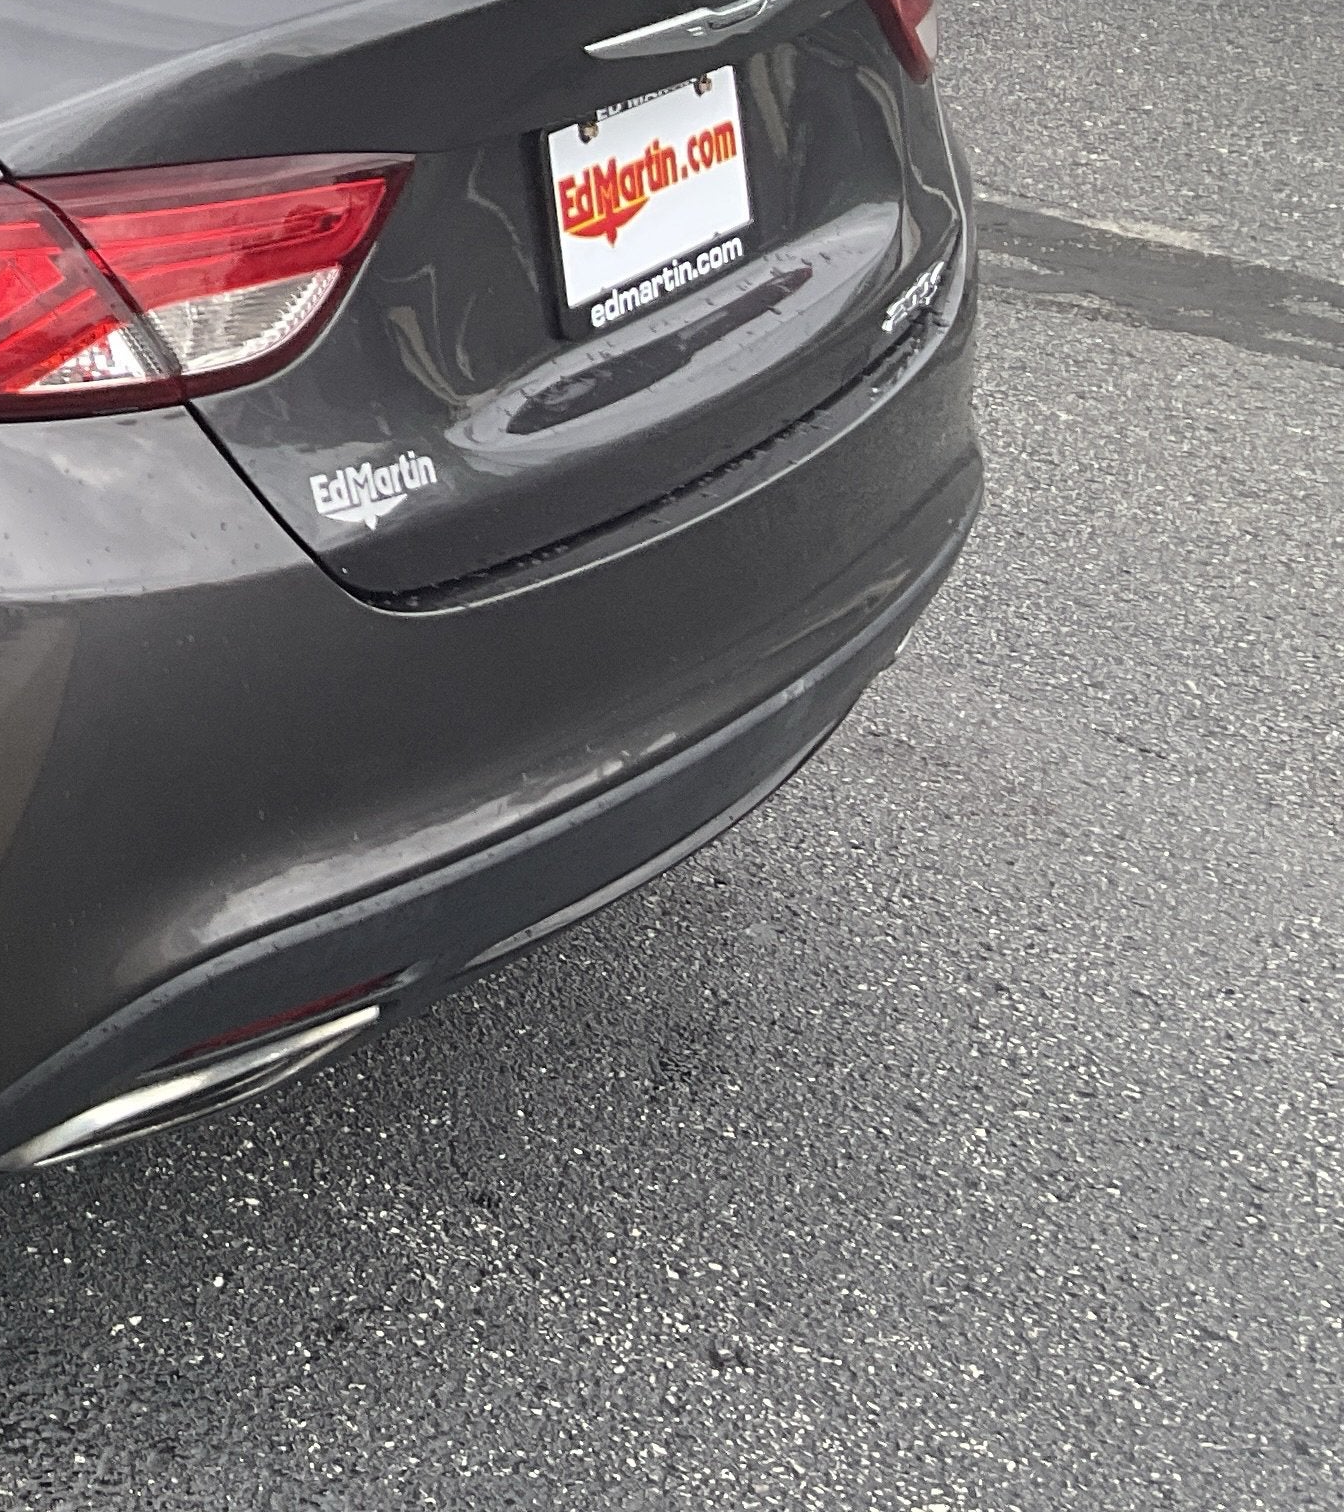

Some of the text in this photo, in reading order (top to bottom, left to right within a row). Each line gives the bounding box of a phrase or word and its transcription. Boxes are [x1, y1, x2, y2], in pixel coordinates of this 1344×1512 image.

[557, 119, 738, 232] EdMartin.com
[590, 233, 743, 329] edmartin.com
[308, 450, 438, 518] EdMartin
